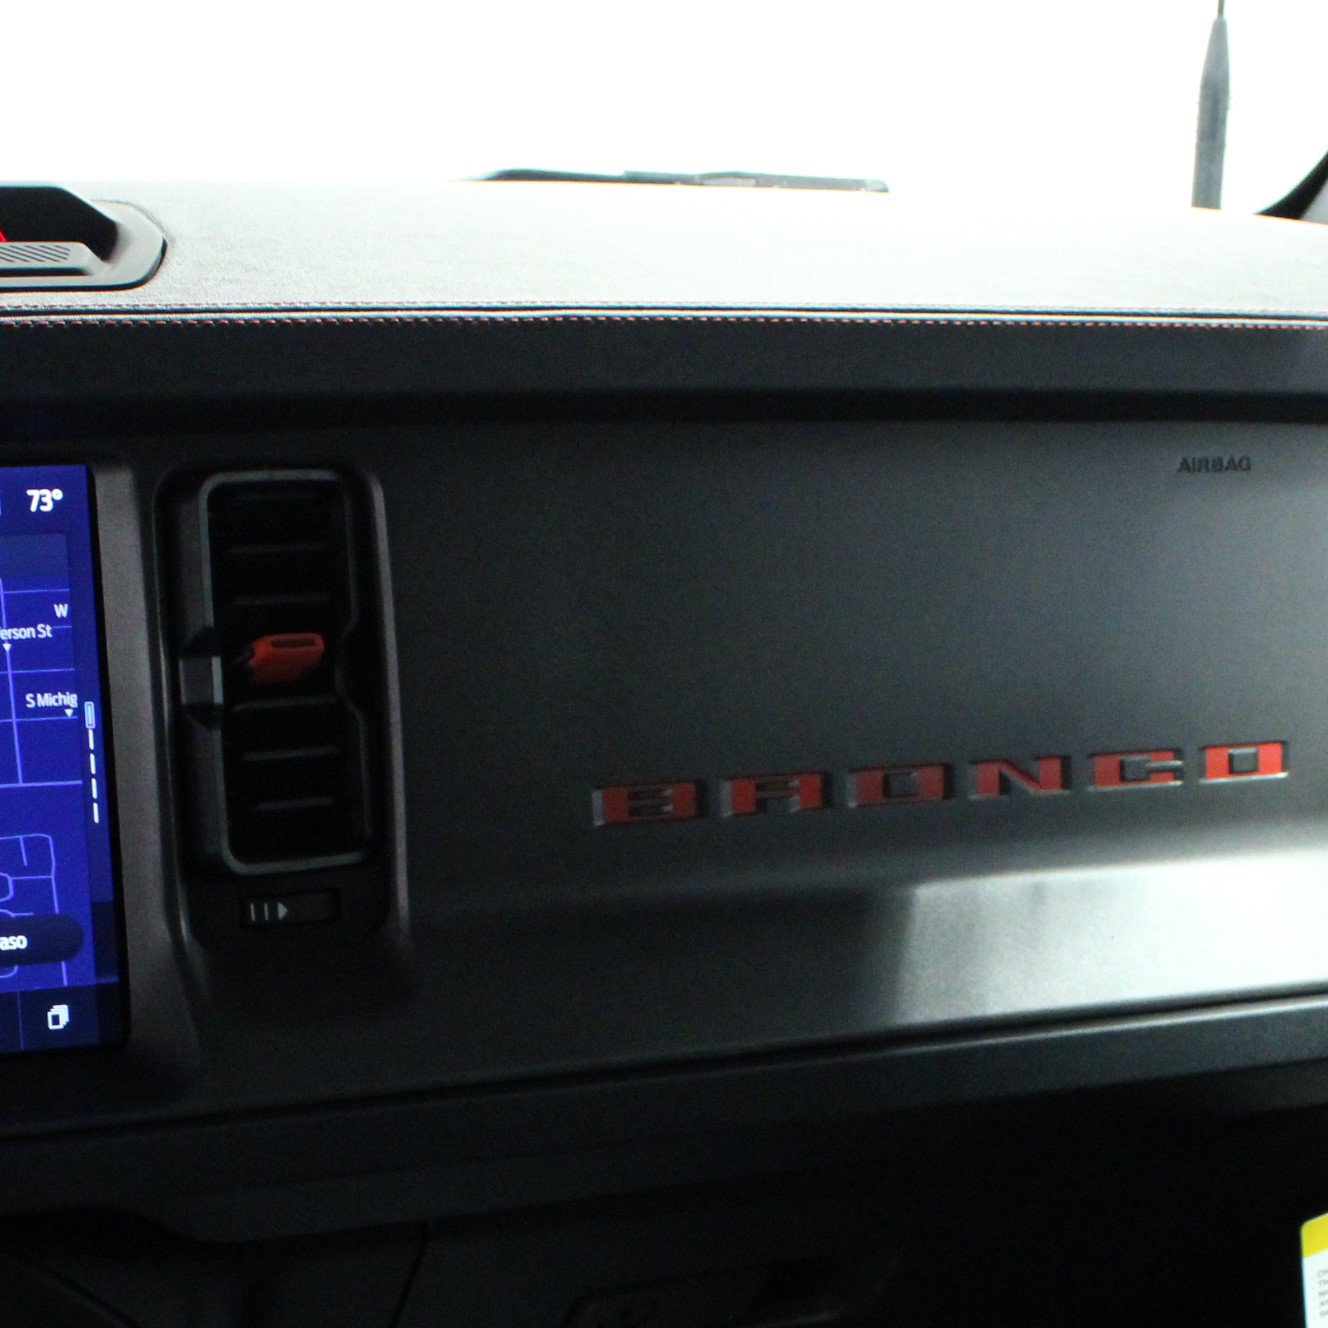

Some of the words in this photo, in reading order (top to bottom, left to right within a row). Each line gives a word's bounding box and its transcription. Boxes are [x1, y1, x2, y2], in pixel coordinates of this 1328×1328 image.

[1177, 455, 1252, 473] AIRBAG
[37, 623, 53, 638] St
[25, 693, 36, 708] S
[591, 741, 1290, 828] BRONCO
